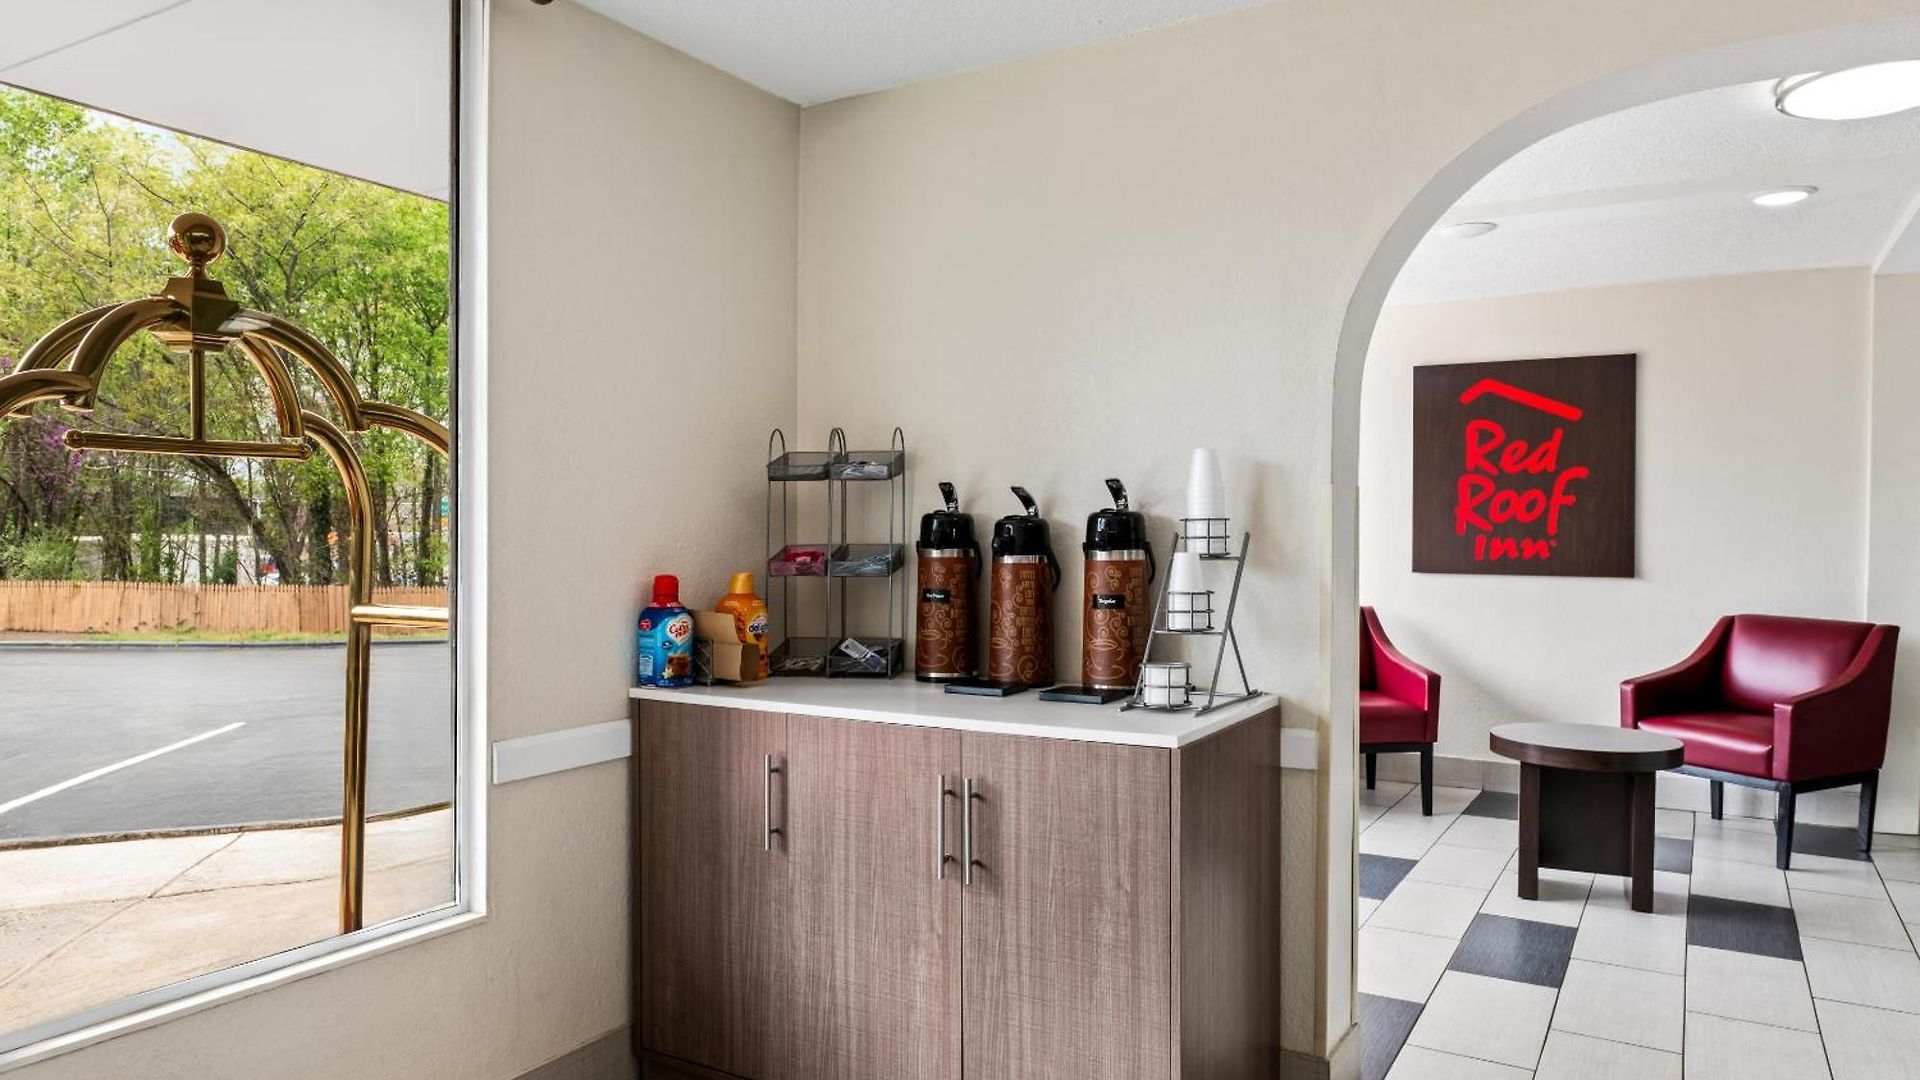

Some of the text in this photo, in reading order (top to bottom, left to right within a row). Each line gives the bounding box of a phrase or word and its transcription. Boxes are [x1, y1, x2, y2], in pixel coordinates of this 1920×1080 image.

[1465, 419, 1564, 476] Red
[1455, 466, 1589, 536] Roof
[1475, 534, 1550, 561] Inn
